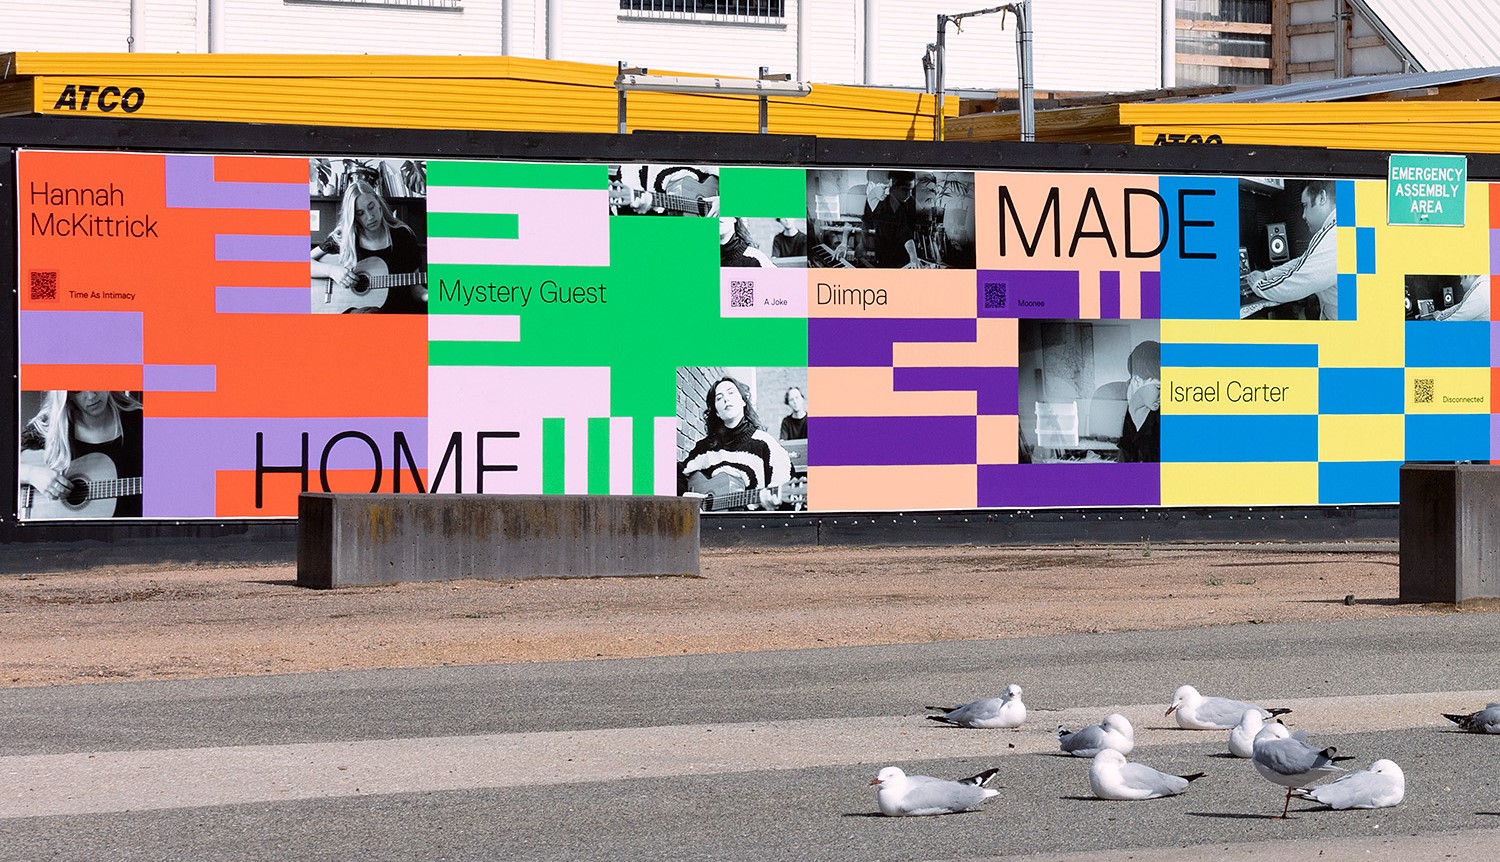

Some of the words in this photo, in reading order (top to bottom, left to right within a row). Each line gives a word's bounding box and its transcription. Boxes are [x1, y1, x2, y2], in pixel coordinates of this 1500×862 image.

[54, 85, 145, 113] ATCO
[1392, 167, 1463, 182] EMERGENCY
[31, 181, 124, 206] Hannah
[1395, 184, 1459, 198] ASSEMBLY
[1410, 200, 1443, 213] AREA
[31, 212, 158, 238] McKittrick
[999, 186, 1217, 259] MADE
[69, 290, 89, 299] Time
[102, 291, 136, 301] Intimacy
[440, 279, 532, 307] Mystery
[540, 280, 607, 304] Guest
[817, 283, 887, 311] Diimpa
[1170, 381, 1219, 402] Israel
[1226, 380, 1289, 402] Carter
